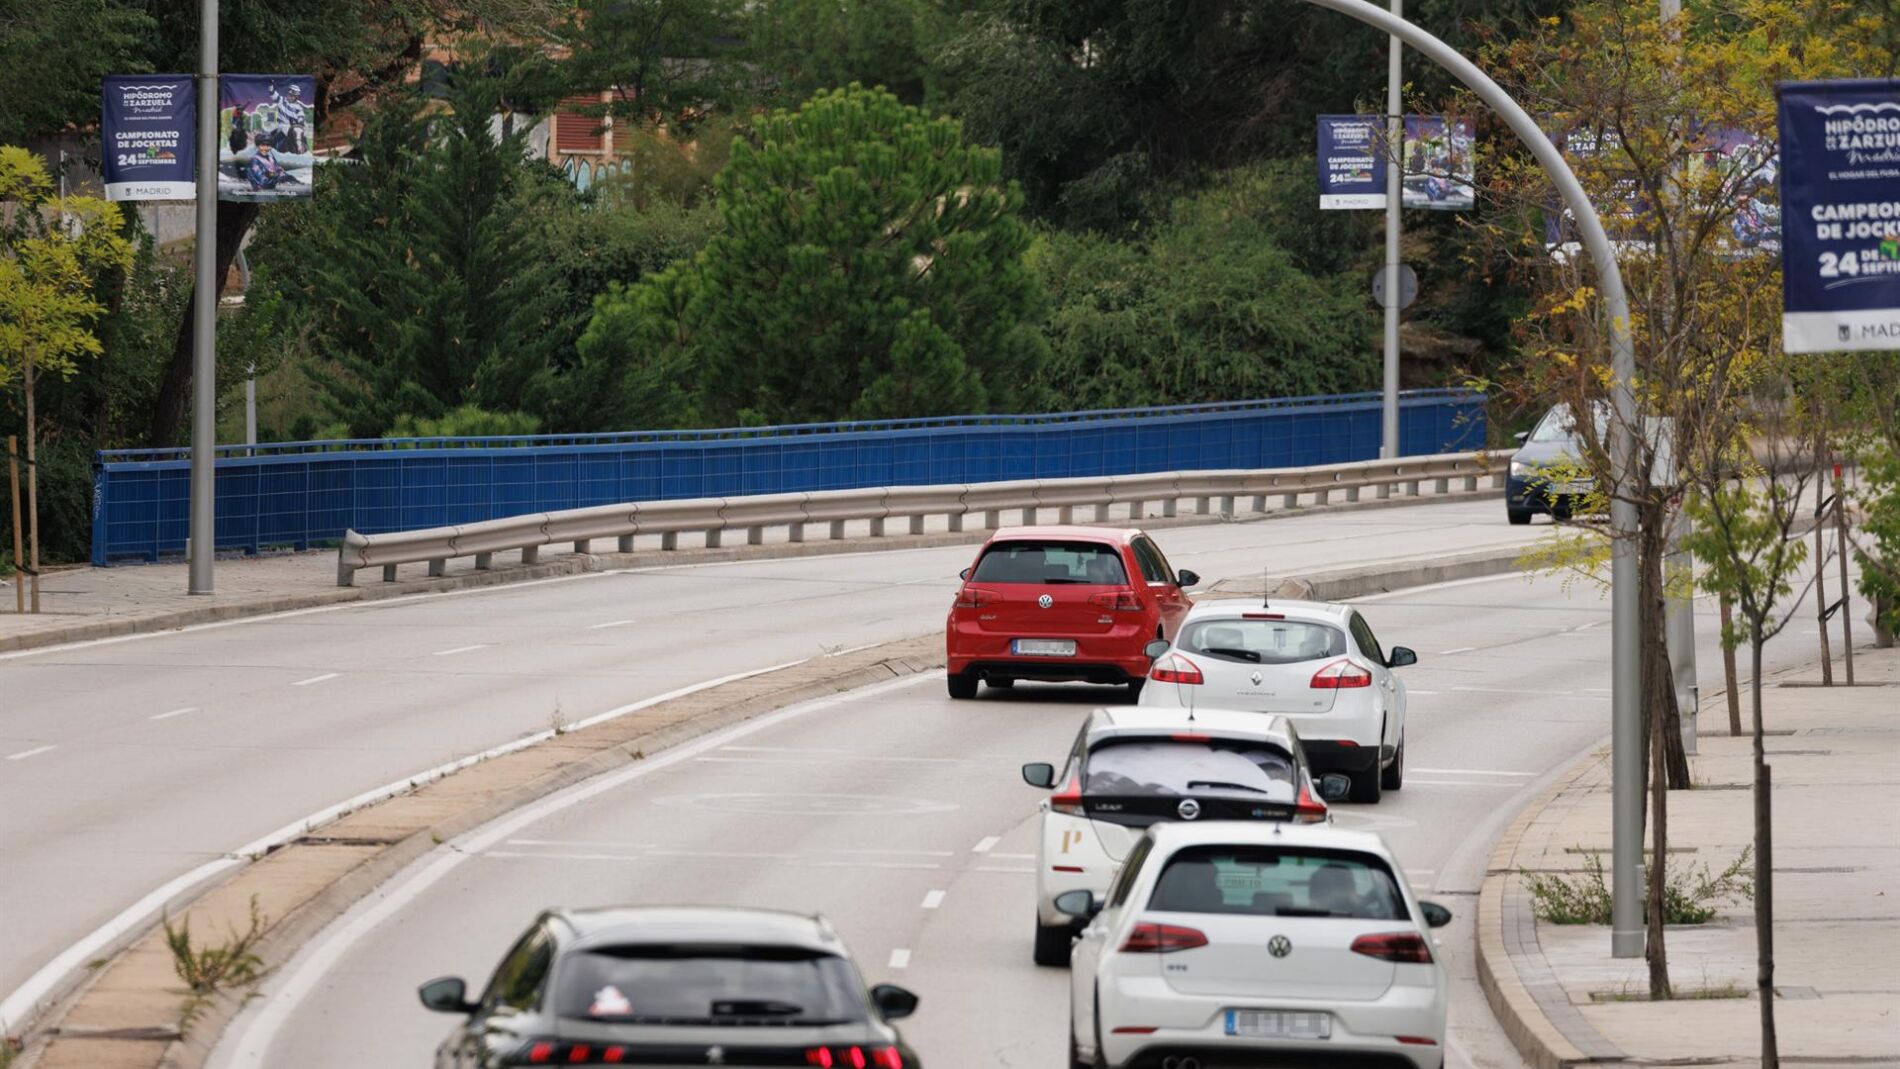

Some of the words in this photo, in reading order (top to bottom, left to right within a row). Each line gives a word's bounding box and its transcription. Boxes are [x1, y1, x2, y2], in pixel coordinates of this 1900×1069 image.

[115, 131, 180, 139] CAMPEONATO
[117, 140, 130, 148] DE
[131, 139, 178, 148] JOCKETAS
[118, 153, 137, 166] 24
[1329, 173, 1344, 183] 24
[136, 187, 171, 195] MADRID
[1816, 222, 1842, 240] DE
[1844, 220, 1900, 239] JOCK
[1860, 249, 1879, 261] DE
[1818, 251, 1860, 277] 24
